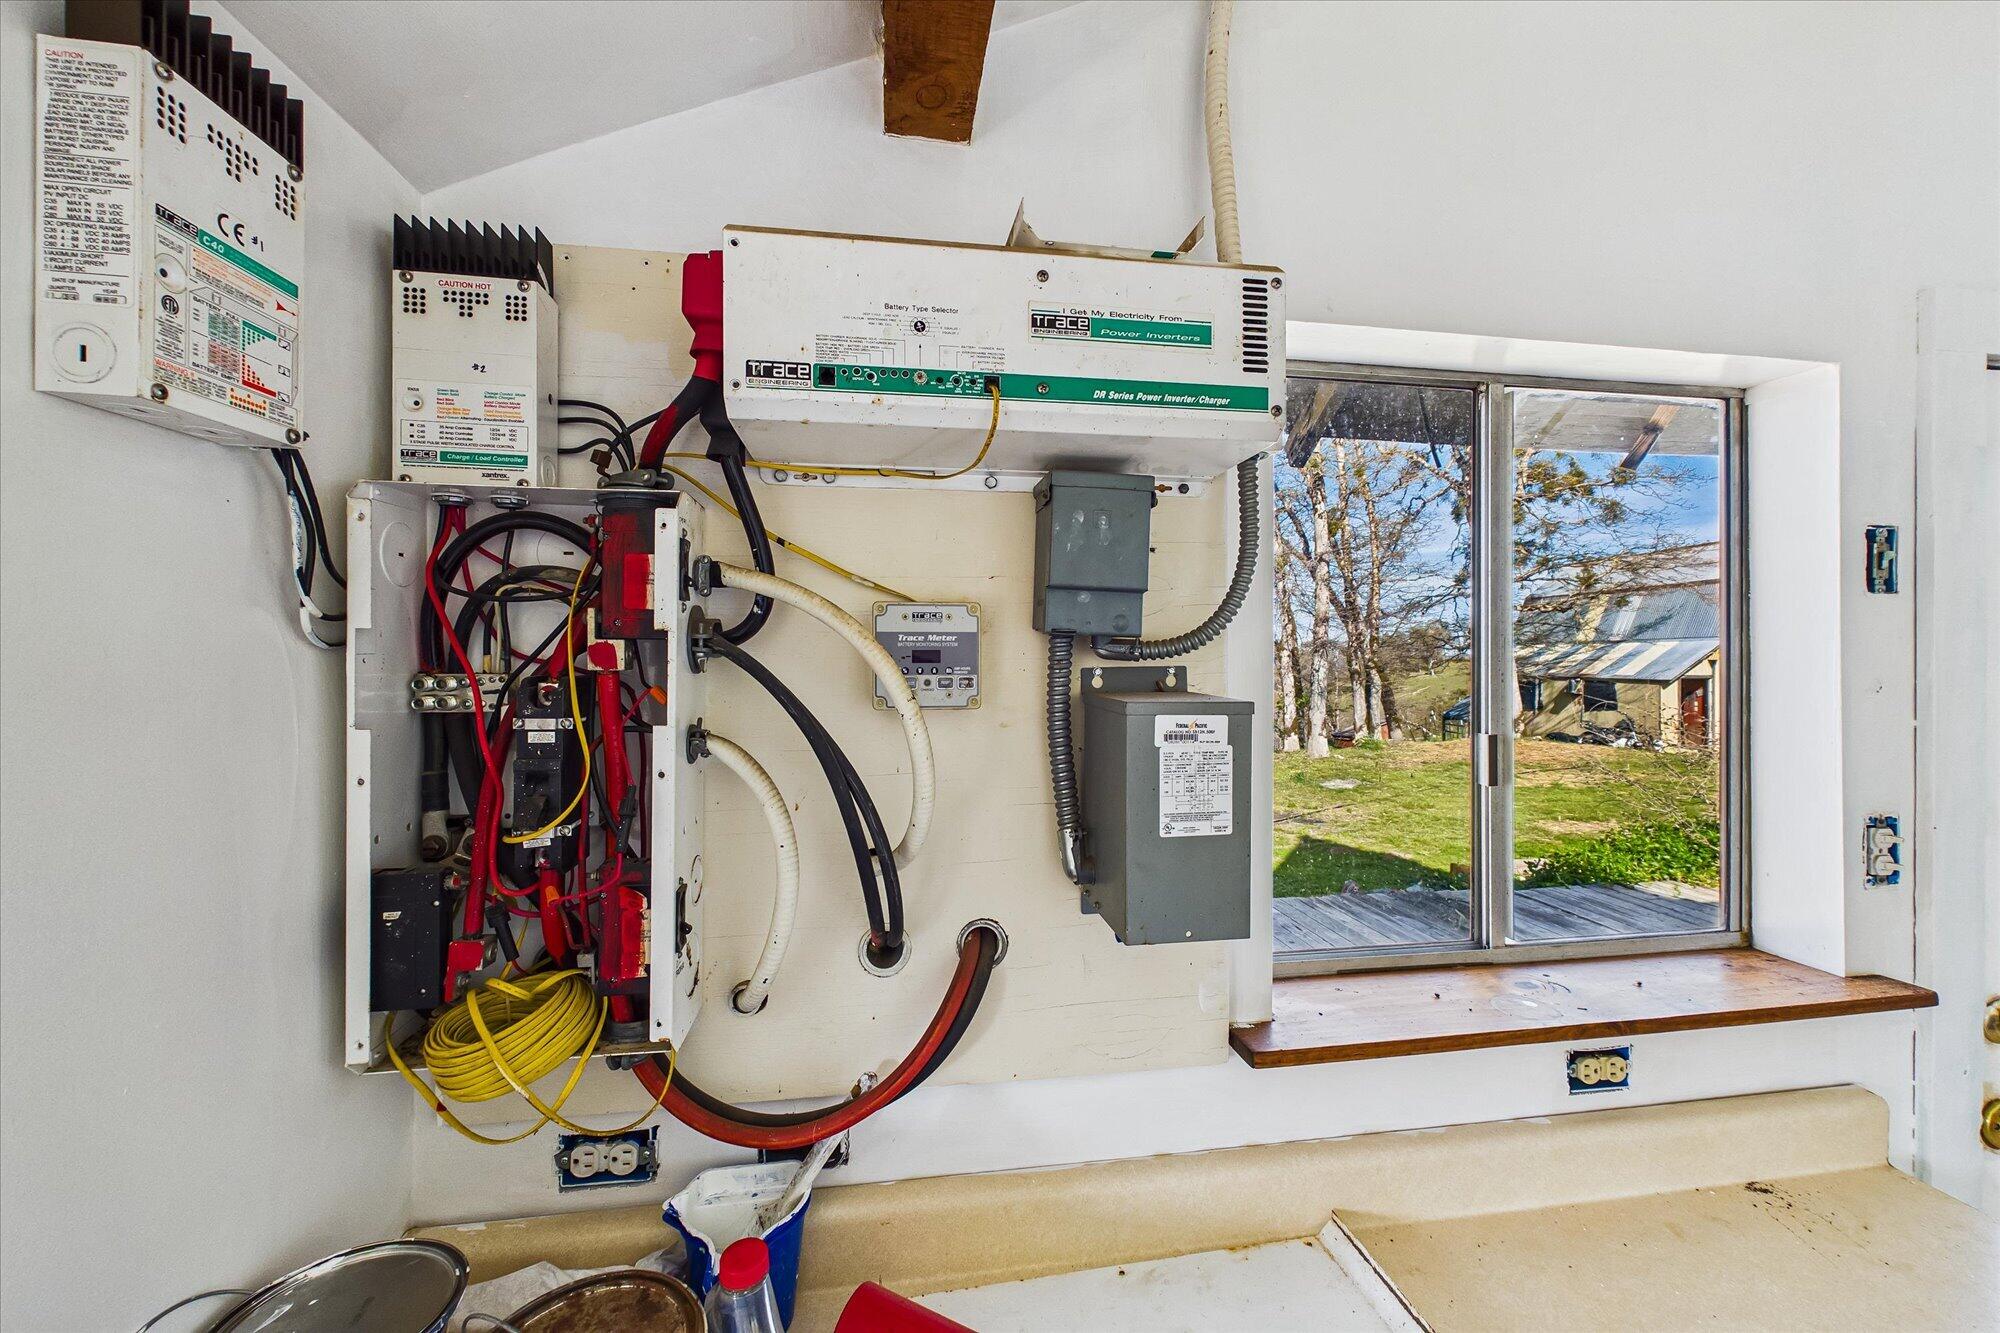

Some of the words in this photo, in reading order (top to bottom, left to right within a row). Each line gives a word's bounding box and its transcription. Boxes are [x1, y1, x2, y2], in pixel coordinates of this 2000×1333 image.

[45, 49, 83, 59] CAUTION
[89, 68, 128, 77] PROTECTED
[56, 221, 97, 229] OPERATING
[203, 236, 224, 254] C40
[251, 236, 263, 252] #1
[438, 280, 473, 289] CAUTION
[193, 296, 221, 311] BATTERY
[884, 303, 908, 312] Battery
[1110, 311, 1154, 321] Electricity
[1100, 329, 1141, 338] Power
[1146, 333, 1200, 341] Inverters
[154, 358, 188, 377] WARNING
[192, 362, 218, 374] BATTERY
[472, 363, 487, 373] #2
[1093, 390, 1106, 399] DR
[1108, 391, 1134, 400] Series
[1136, 392, 1161, 401] Power
[1164, 394, 1229, 406] Inverter/Charger
